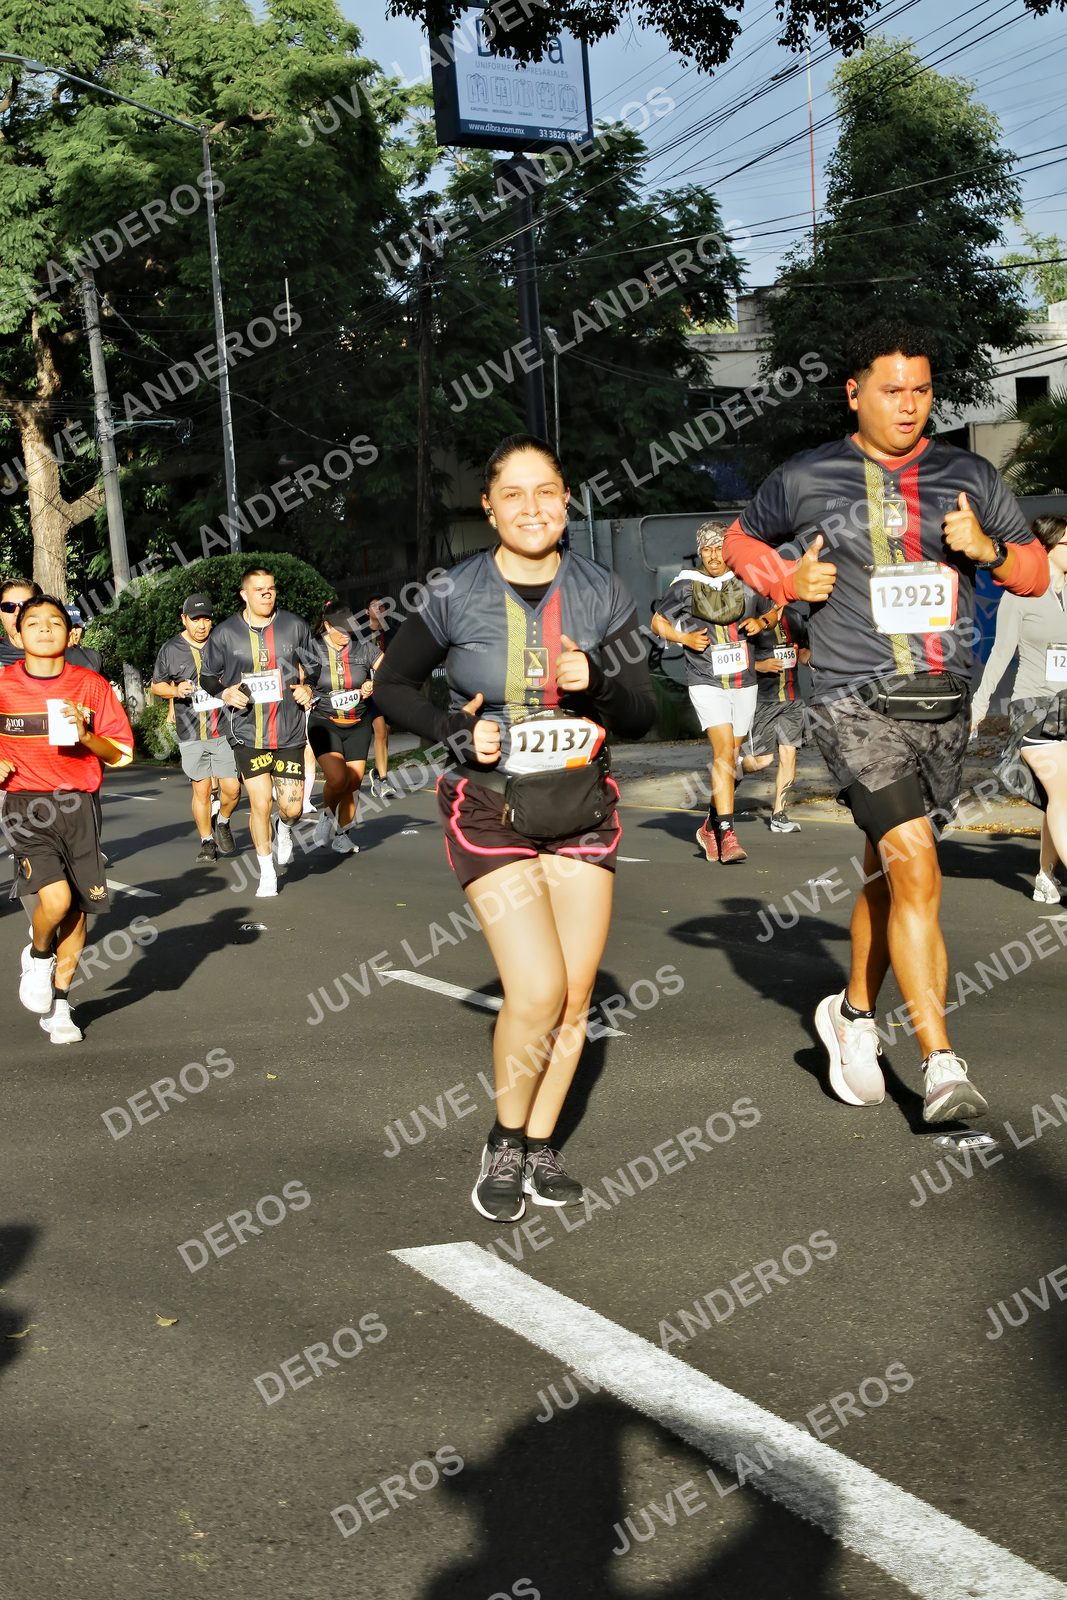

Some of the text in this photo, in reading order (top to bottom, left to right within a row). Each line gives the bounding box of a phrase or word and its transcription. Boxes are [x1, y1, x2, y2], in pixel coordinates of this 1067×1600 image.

[475, 60, 515, 73] UNIFORMES
[469, 123, 525, 135] www.dibra.com.mx
[539, 129, 548, 138] 33
[549, 130, 566, 139] 3826
[876, 583, 946, 608] 12923
[717, 652, 741, 665] 8018
[775, 650, 796, 661] 12456
[1053, 655, 1067, 668] 12
[250, 680, 277, 693] 0355
[333, 693, 359, 707] 12240
[517, 727, 592, 753] 12137
